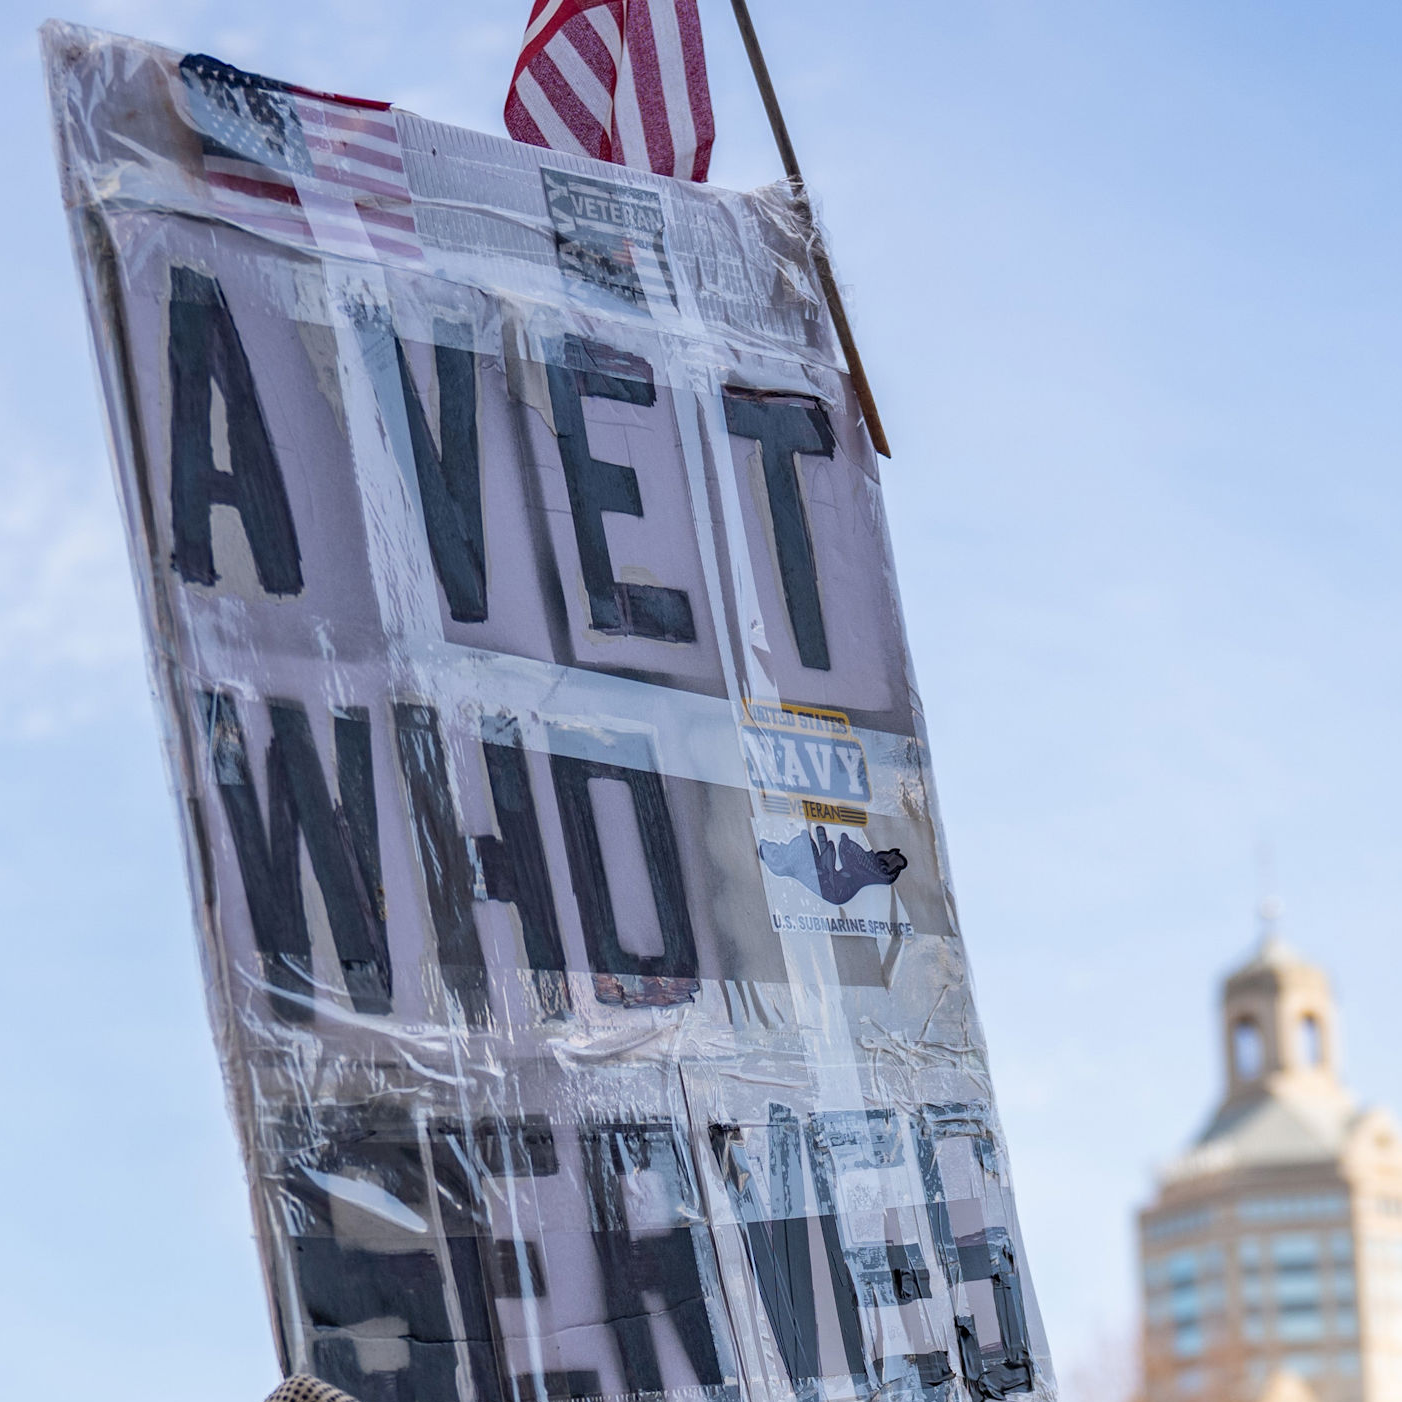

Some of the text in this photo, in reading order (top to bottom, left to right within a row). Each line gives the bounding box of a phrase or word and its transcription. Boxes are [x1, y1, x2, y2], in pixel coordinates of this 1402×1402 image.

[569, 193, 664, 233] VETERAN
[167, 262, 836, 672] A VET
[750, 703, 848, 735] UNITED STATES
[744, 733, 864, 795] NAVY
[789, 801, 840, 820] VETERAN
[198, 690, 700, 1023] WHO
[772, 914, 913, 936] U.S. SUBMARINE SERVICE
